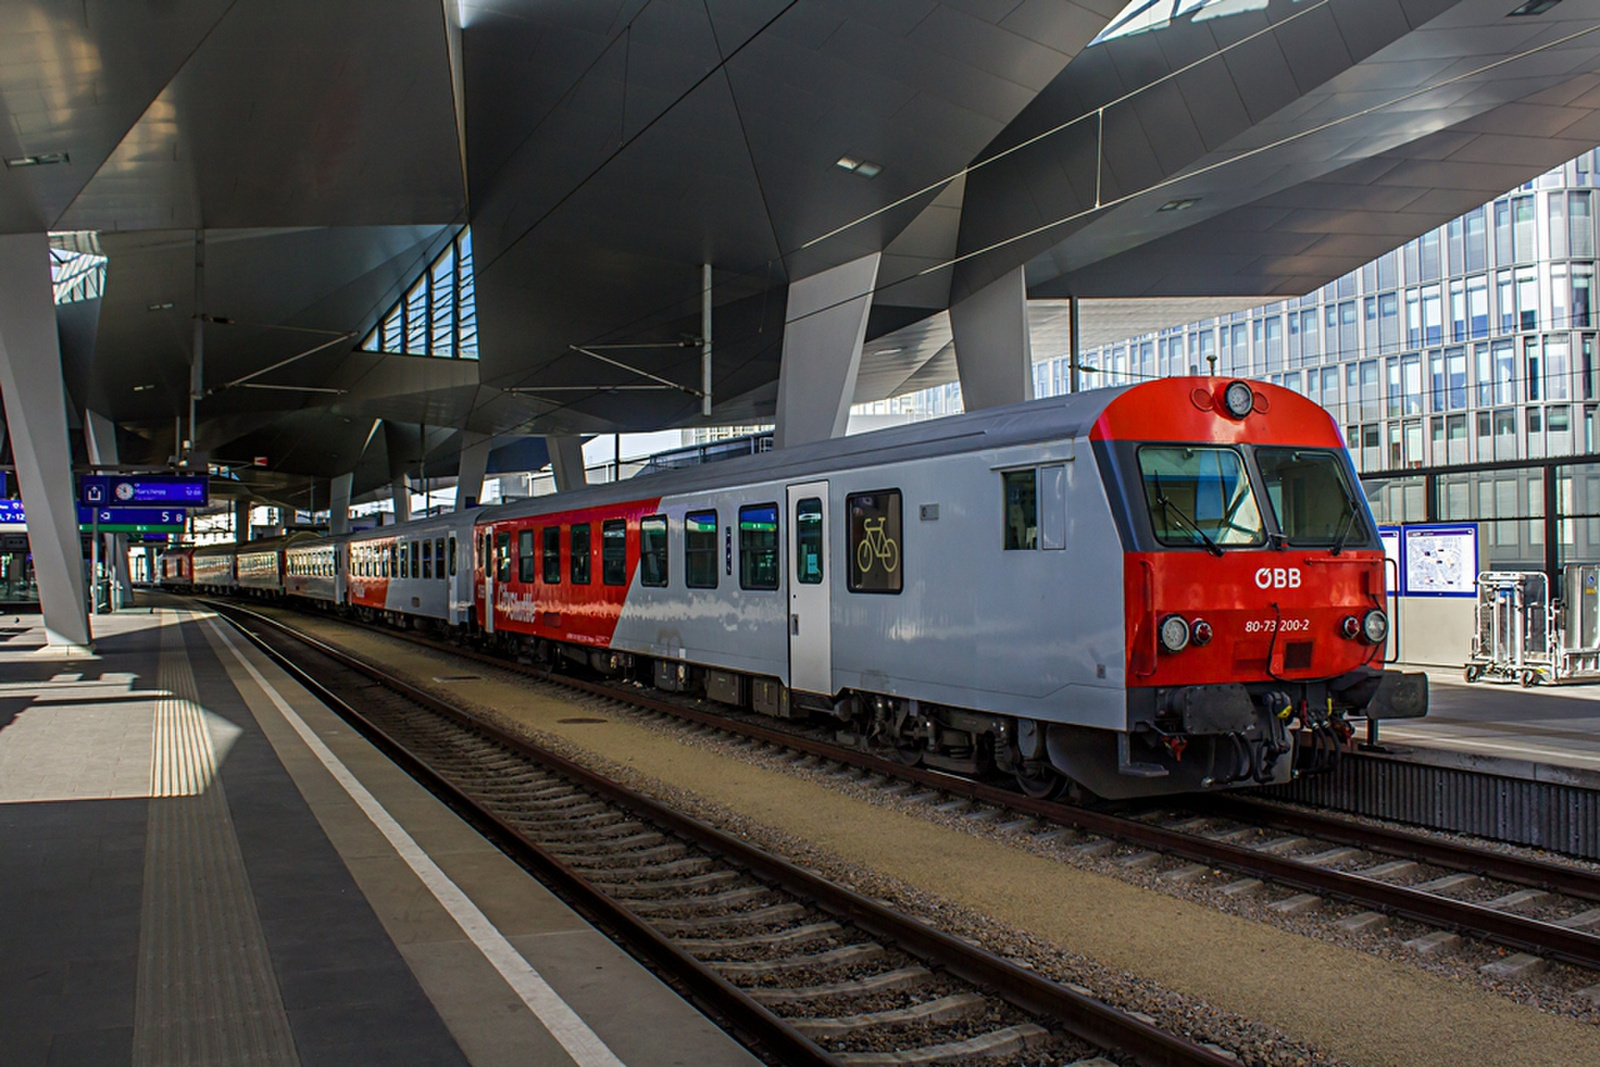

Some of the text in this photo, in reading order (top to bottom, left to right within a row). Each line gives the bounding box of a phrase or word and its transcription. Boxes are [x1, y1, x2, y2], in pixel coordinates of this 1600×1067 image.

[162, 511, 170, 522] 5
[1255, 568, 1301, 589] ÖBB
[1280, 619, 1310, 631] 200-2
